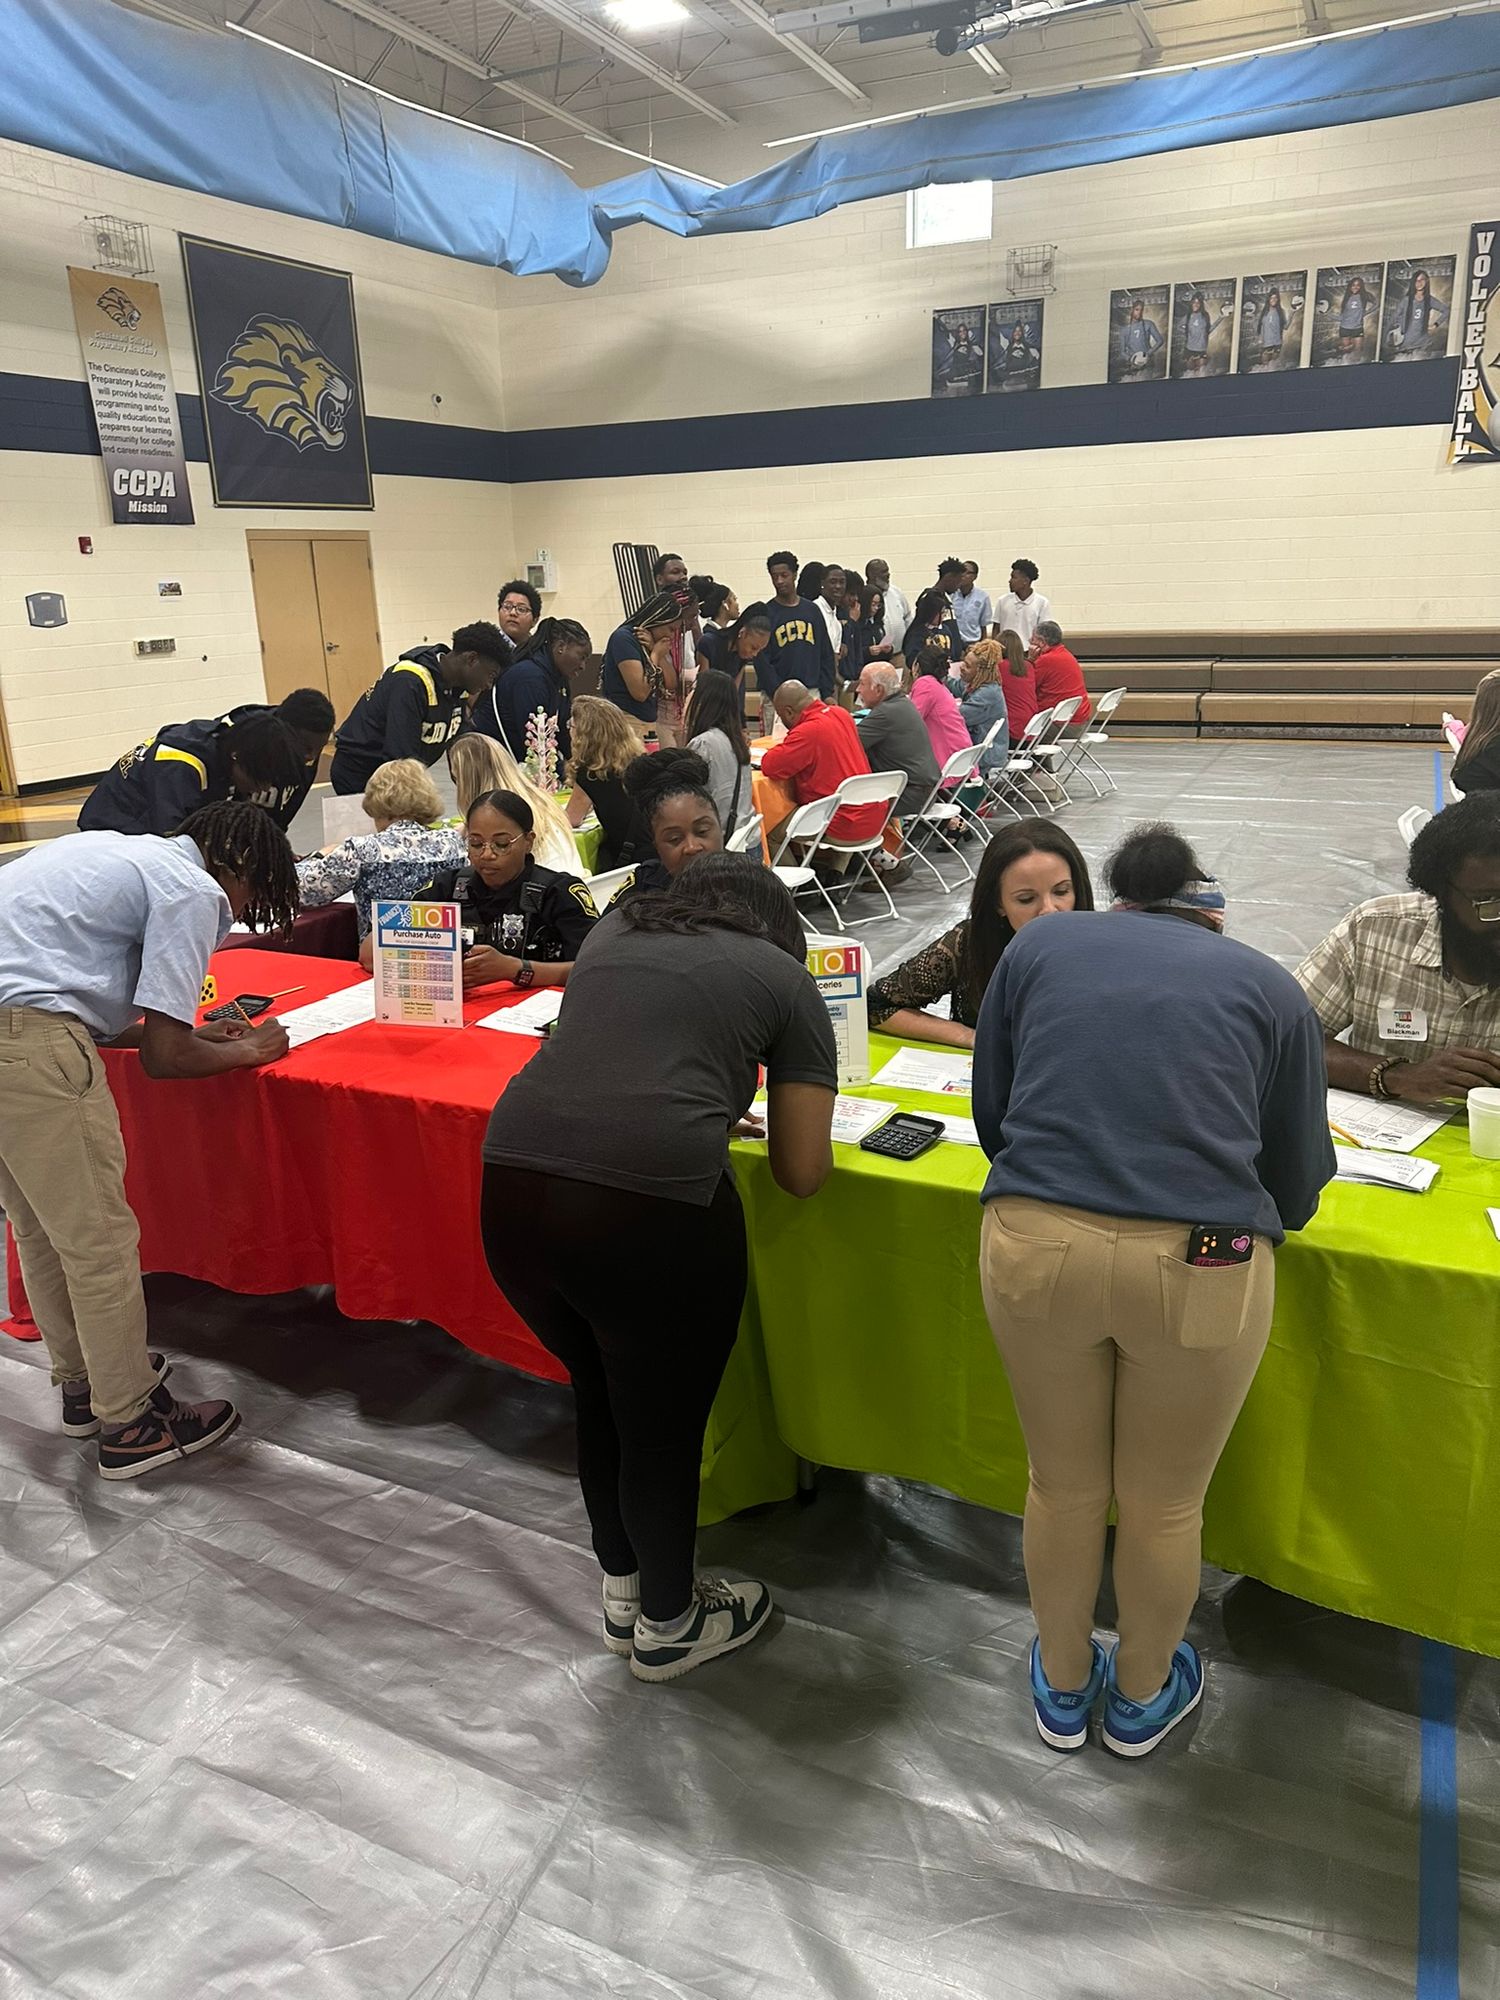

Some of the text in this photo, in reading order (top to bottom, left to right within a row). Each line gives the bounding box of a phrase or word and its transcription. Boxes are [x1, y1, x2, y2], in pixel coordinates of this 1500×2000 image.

[1413, 308, 1422, 319] 3
[1133, 329, 1141, 339] 7
[1455, 231, 1495, 456] VOLLEYBALL
[88, 362, 166, 380] The Cincinnati College
[91, 374, 166, 392] Preparatory Academy
[97, 387, 164, 401] will provide holistic
[95, 400, 170, 414] programming and top
[97, 410, 171, 424] quality education that
[99, 422, 131, 432] prepares
[145, 425, 172, 436] learning
[101, 434, 176, 447] community for college
[103, 445, 175, 457] and career readiness.
[113, 468, 177, 498] CCPA
[128, 500, 168, 514] Mission
[775, 620, 815, 647] CCPA
[393, 930, 442, 940] Purchase Auto
[1387, 1028, 1420, 1036] Blackman
[1057, 1695, 1077, 1706] NIKE
[1114, 1699, 1134, 1714] NIKE
